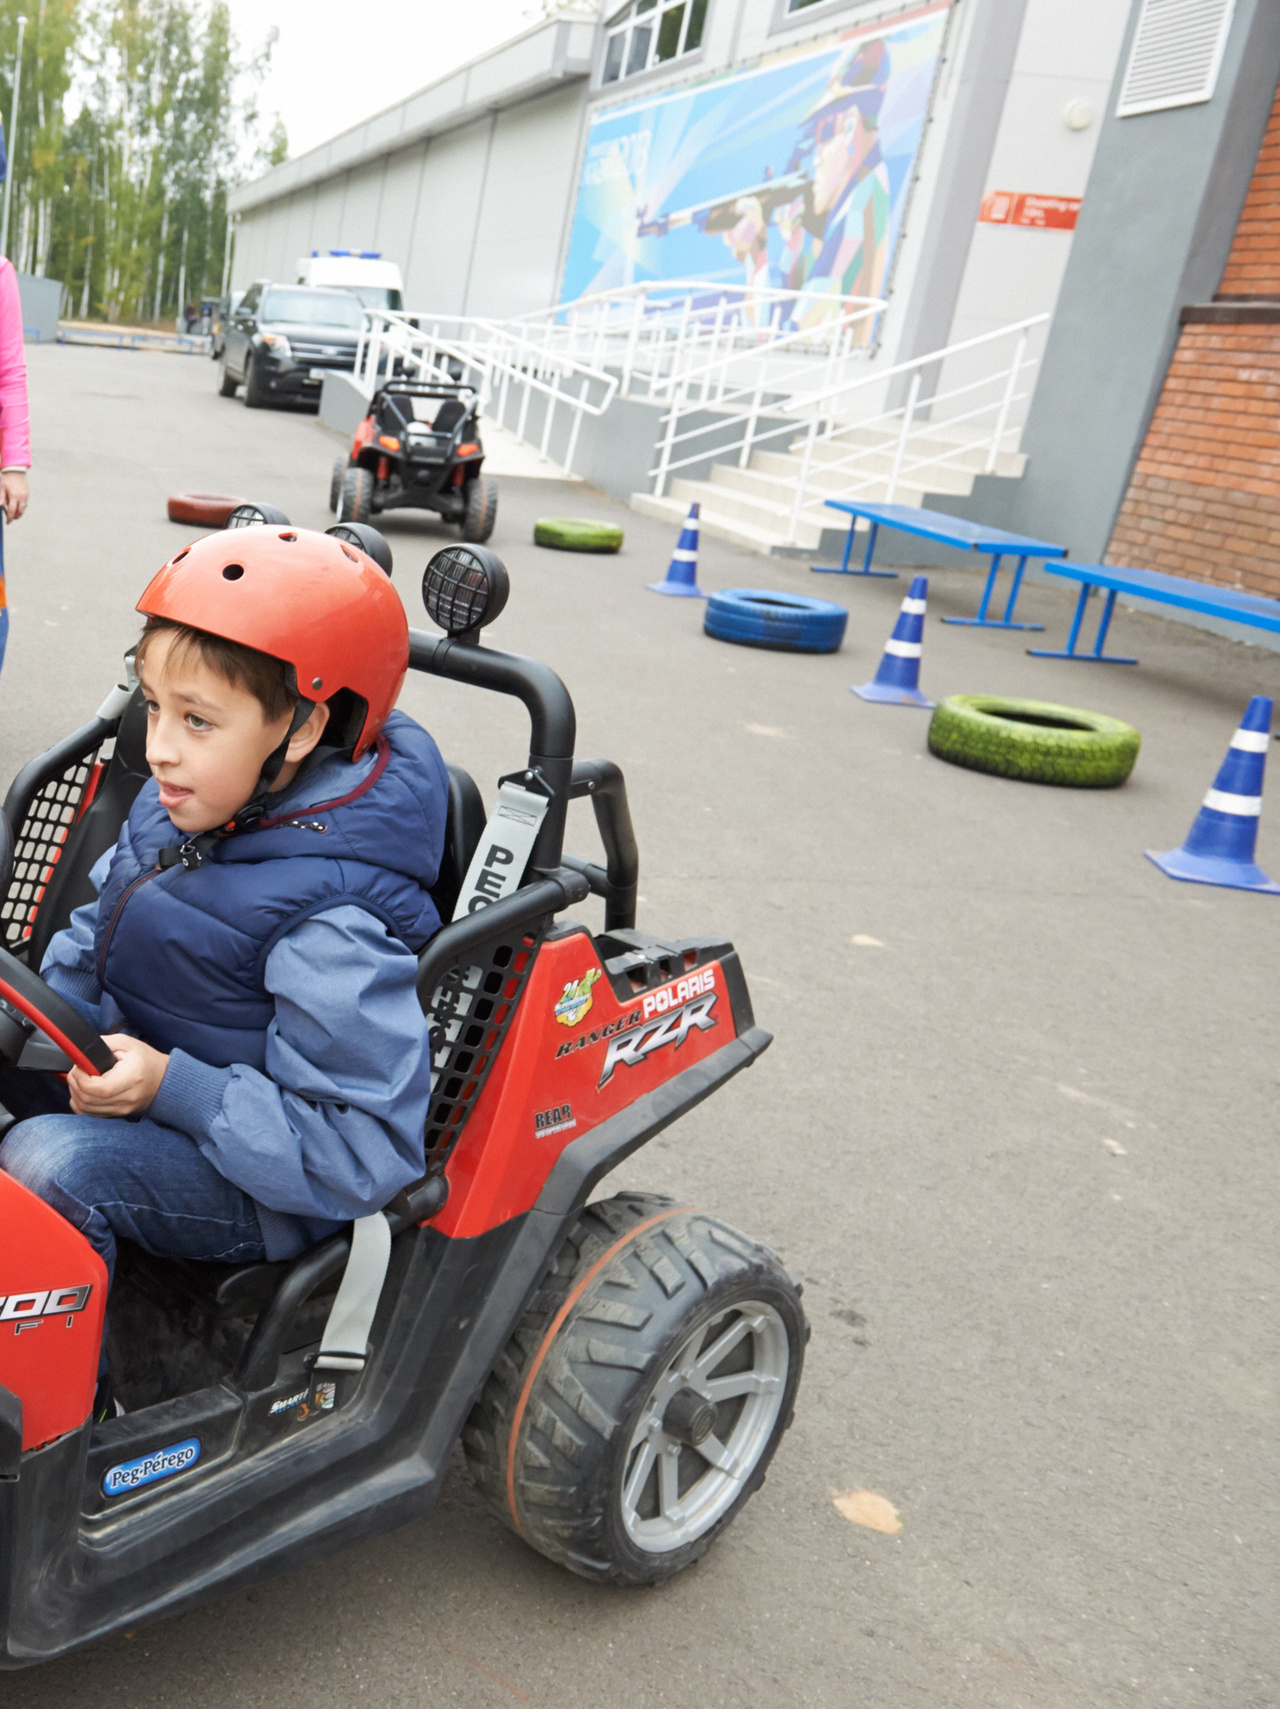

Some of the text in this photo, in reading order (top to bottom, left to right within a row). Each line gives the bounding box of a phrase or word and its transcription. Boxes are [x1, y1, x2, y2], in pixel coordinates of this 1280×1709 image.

[643, 969, 715, 1019] POLARIS
[555, 1009, 642, 1060] RANGER
[596, 991, 718, 1091] RZR
[535, 1103, 572, 1129] REAR
[109, 1445, 195, 1489] Peg-Pérego
